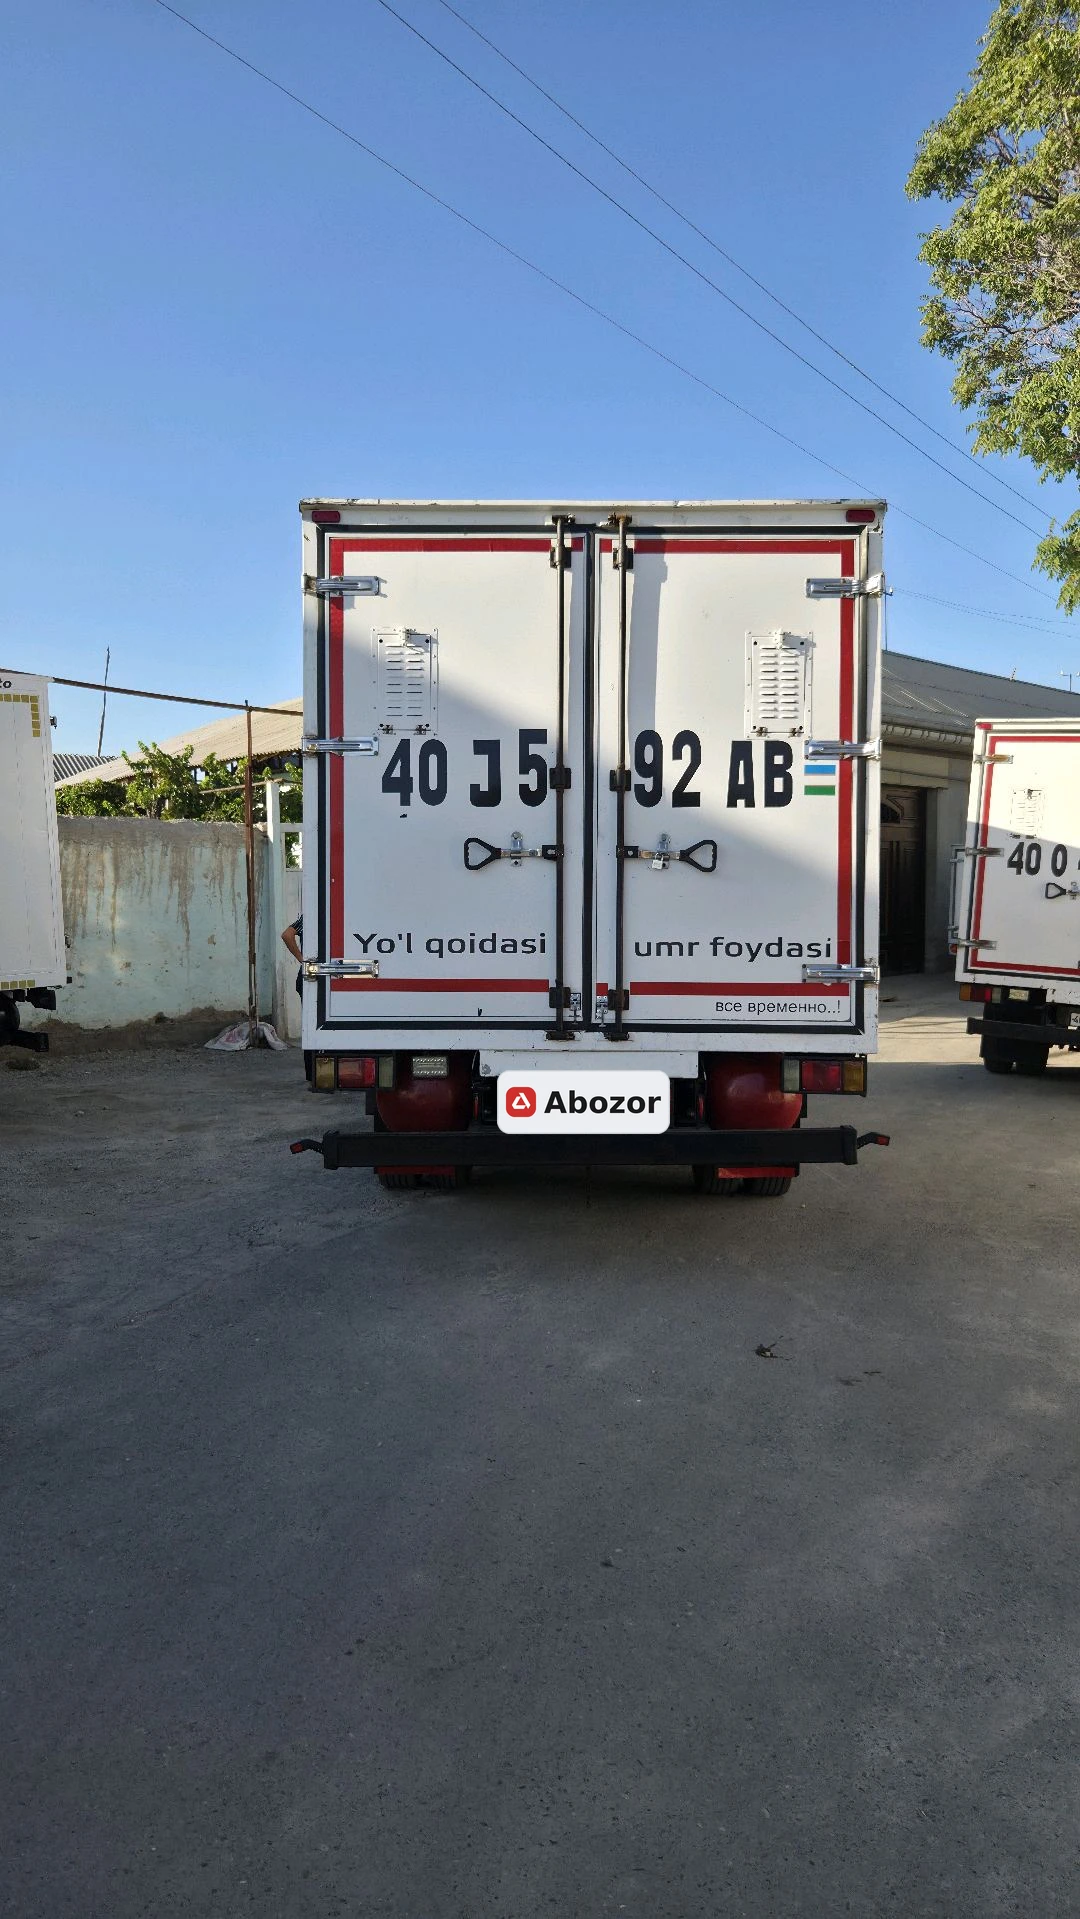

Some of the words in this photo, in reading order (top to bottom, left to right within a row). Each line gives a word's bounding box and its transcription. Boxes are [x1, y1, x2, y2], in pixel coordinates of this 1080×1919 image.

[381, 739, 448, 807] 40
[726, 740, 794, 809] AB
[1007, 841, 1042, 876] 40
[352, 932, 413, 954] Yo'l
[425, 932, 547, 959] qoidasi
[634, 941, 700, 957] umr
[709, 936, 832, 963] foydasi
[714, 1001, 743, 1012] все
